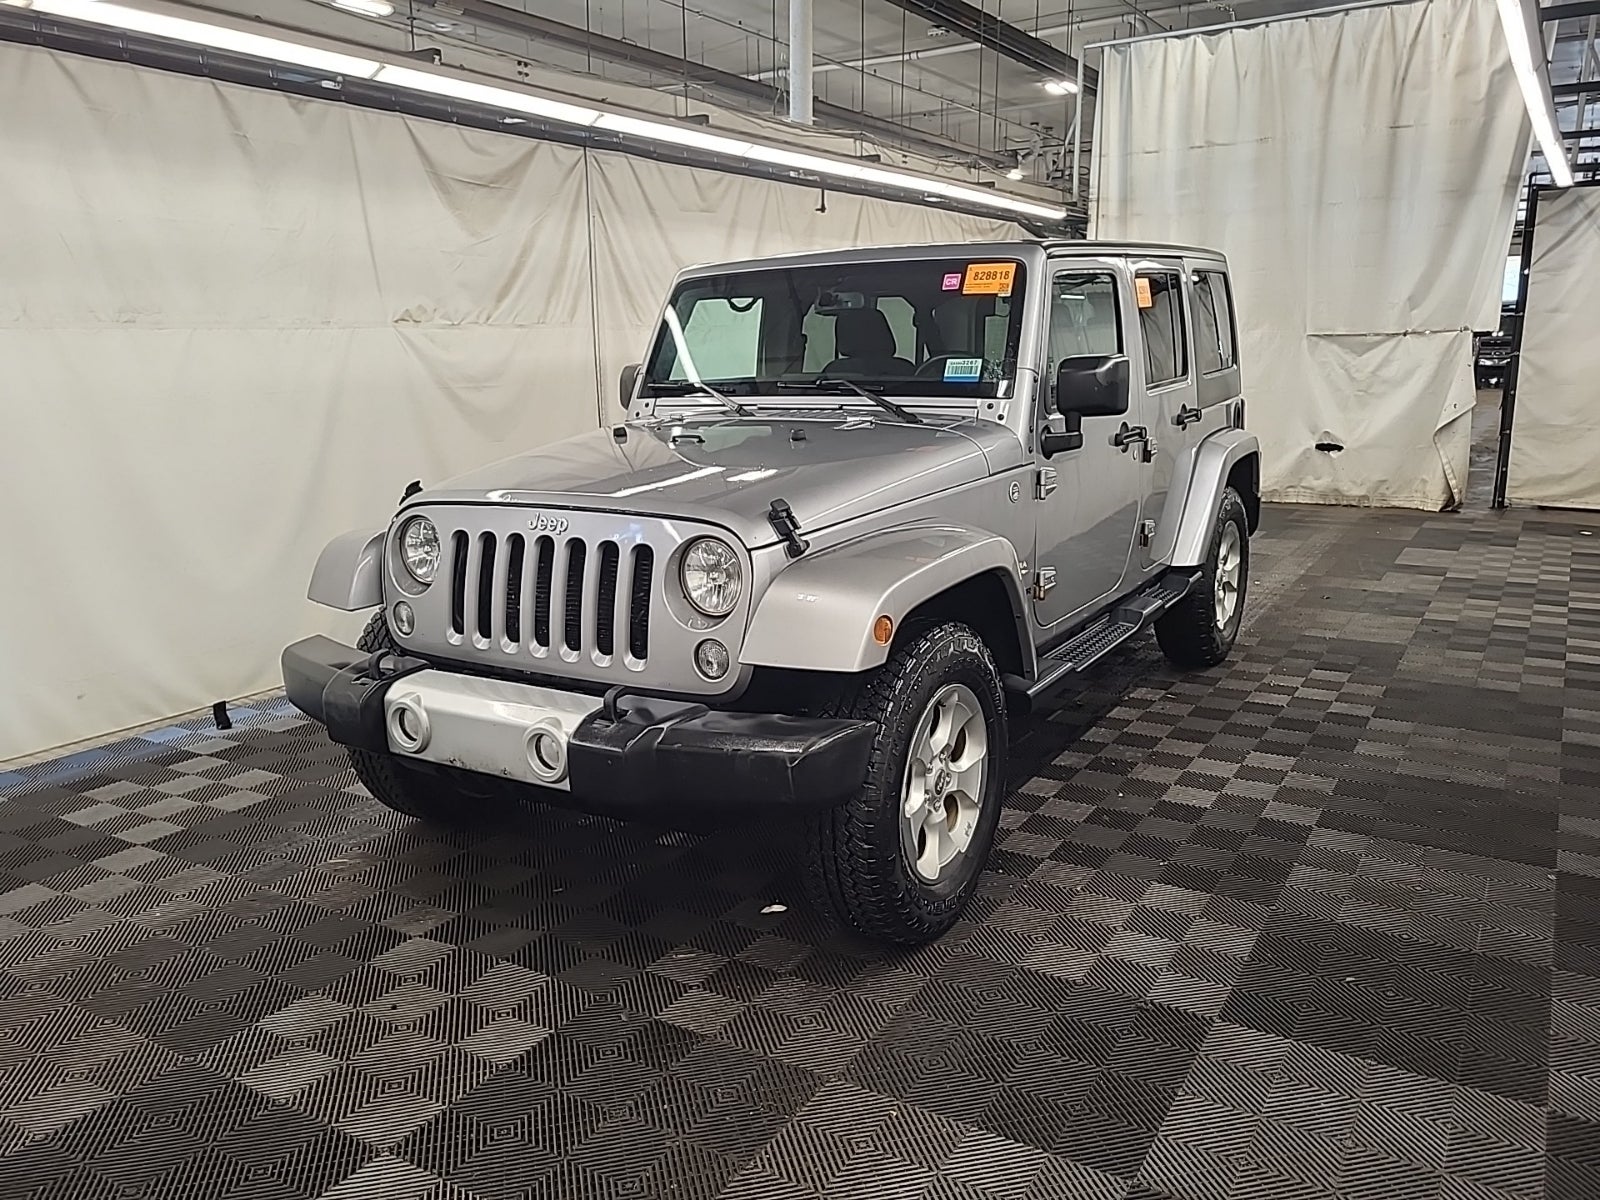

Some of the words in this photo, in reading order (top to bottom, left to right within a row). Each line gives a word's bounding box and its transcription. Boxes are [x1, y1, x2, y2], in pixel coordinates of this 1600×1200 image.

[973, 270, 1010, 281] 828818
[945, 278, 958, 286] CR
[528, 512, 569, 536] Jeep
